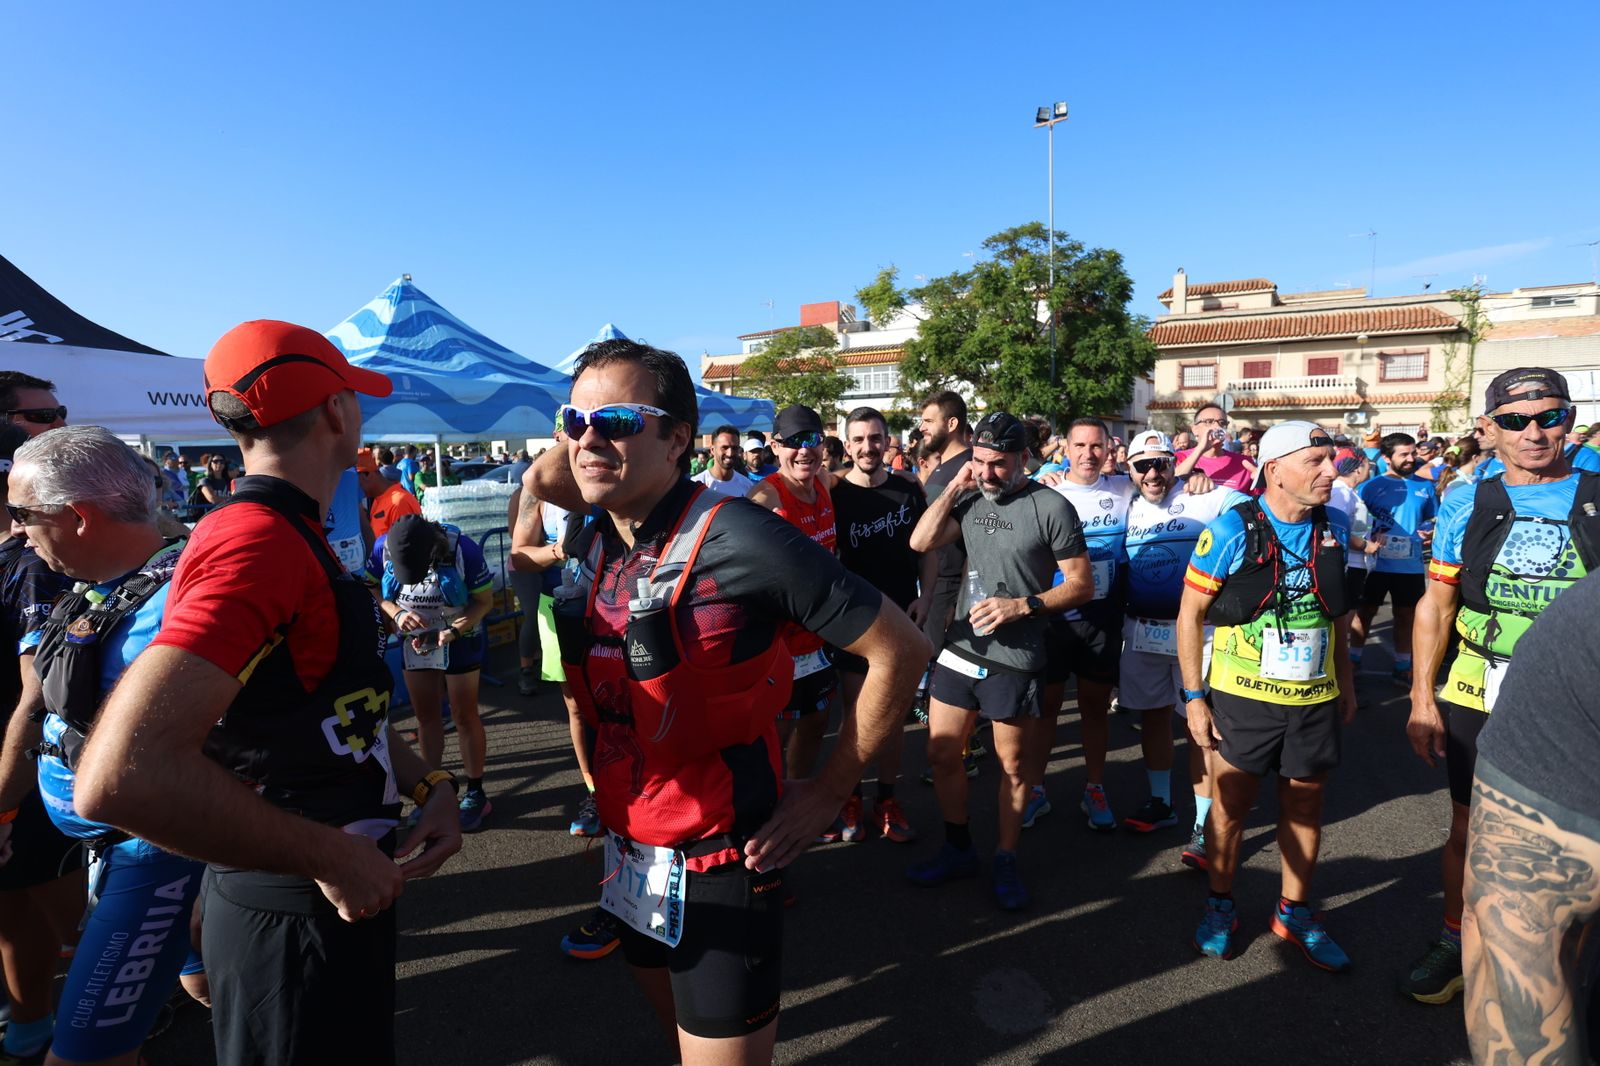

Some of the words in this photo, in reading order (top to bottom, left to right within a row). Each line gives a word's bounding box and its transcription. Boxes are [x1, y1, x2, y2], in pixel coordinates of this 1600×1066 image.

[974, 518, 1013, 531] MARBELLA
[1103, 513, 1118, 526] Go
[1127, 525, 1151, 539] Stop
[1154, 522, 1164, 533] &
[1166, 518, 1187, 532] Go
[1278, 646, 1313, 662] 513
[1236, 675, 1291, 696] OBJETIVO
[95, 874, 192, 1028] LEBRIJA
[84, 931, 129, 996] ATLETISMO
[71, 998, 98, 1029] CLUB
